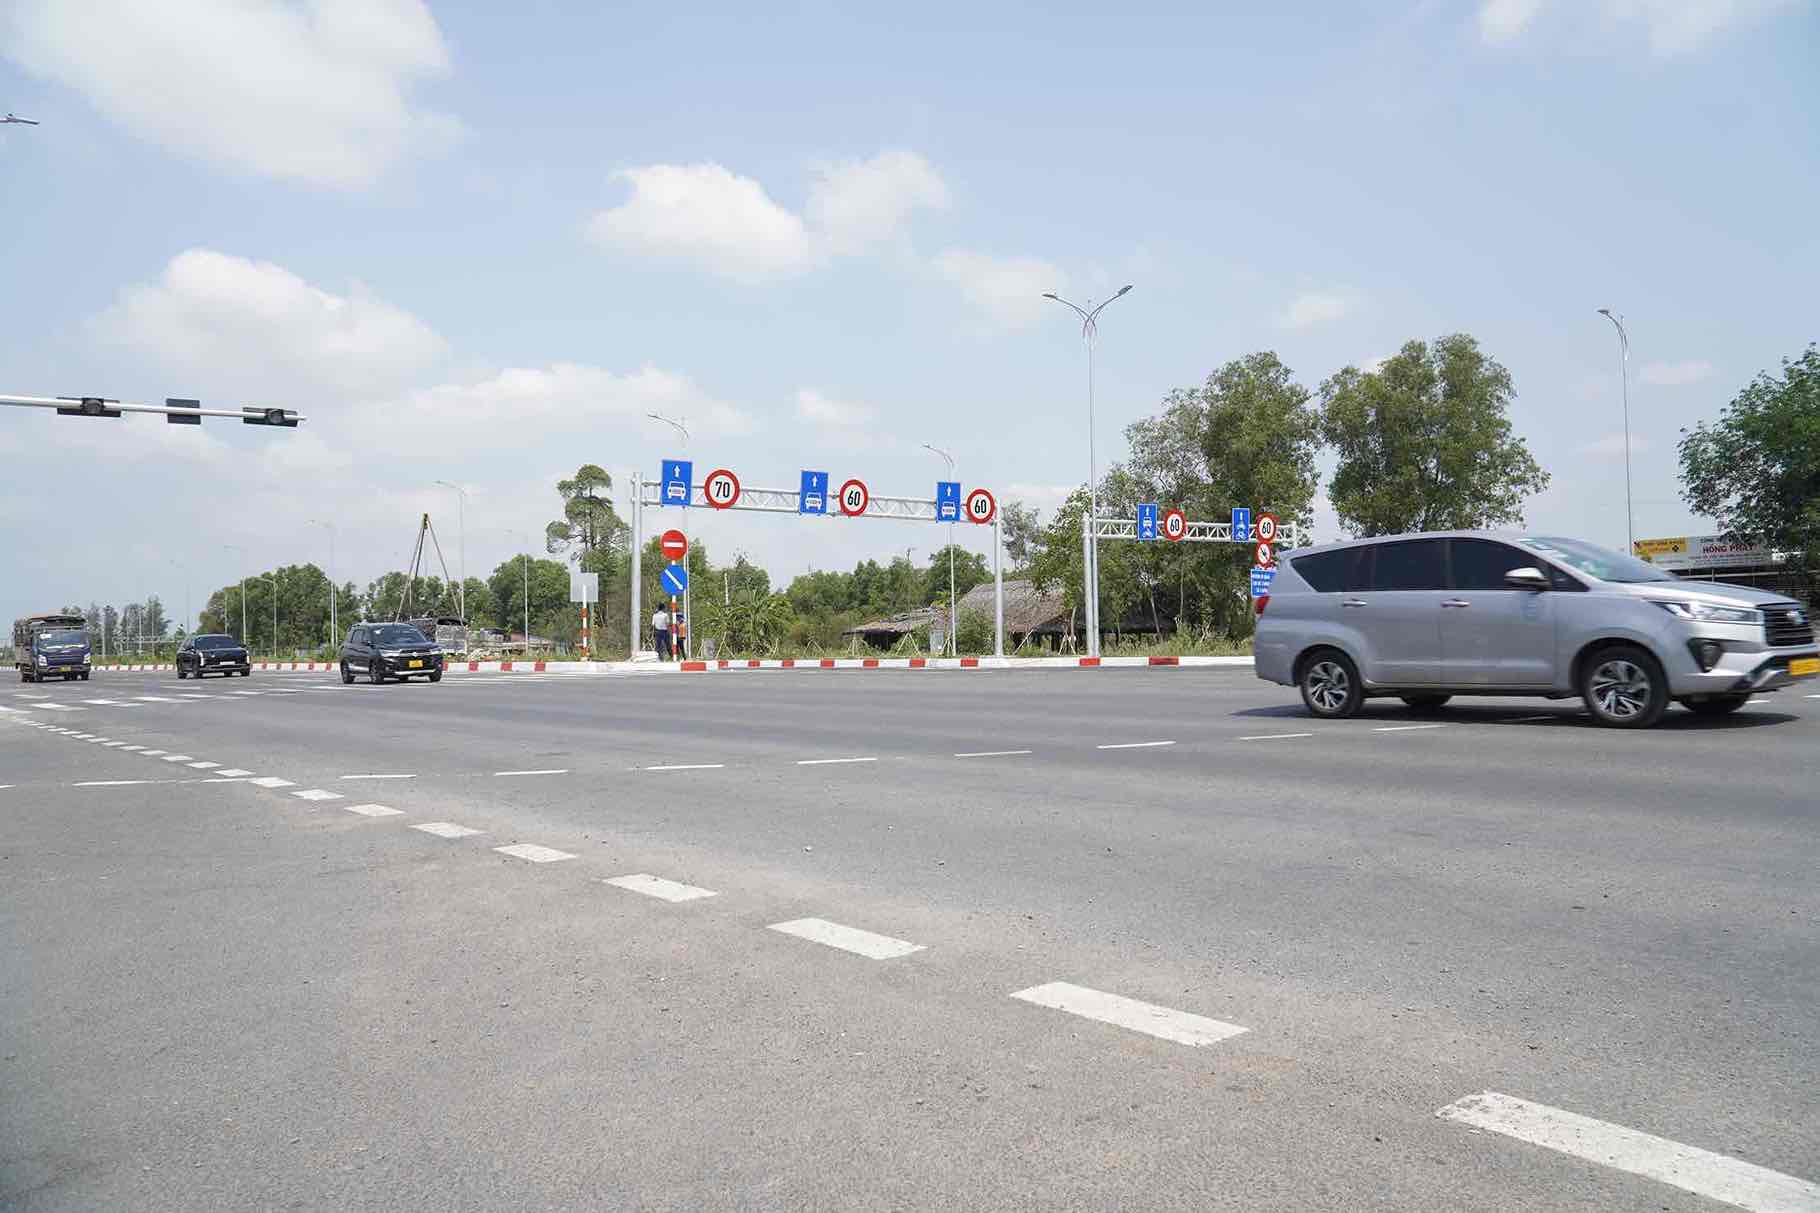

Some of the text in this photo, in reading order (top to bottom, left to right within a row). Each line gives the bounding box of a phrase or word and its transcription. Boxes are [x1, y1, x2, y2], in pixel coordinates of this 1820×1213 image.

[715, 481, 730, 498] 70
[848, 490, 861, 507] 60
[974, 499, 987, 514] 60
[1169, 518, 1180, 532] 60
[1261, 521, 1272, 535] 60
